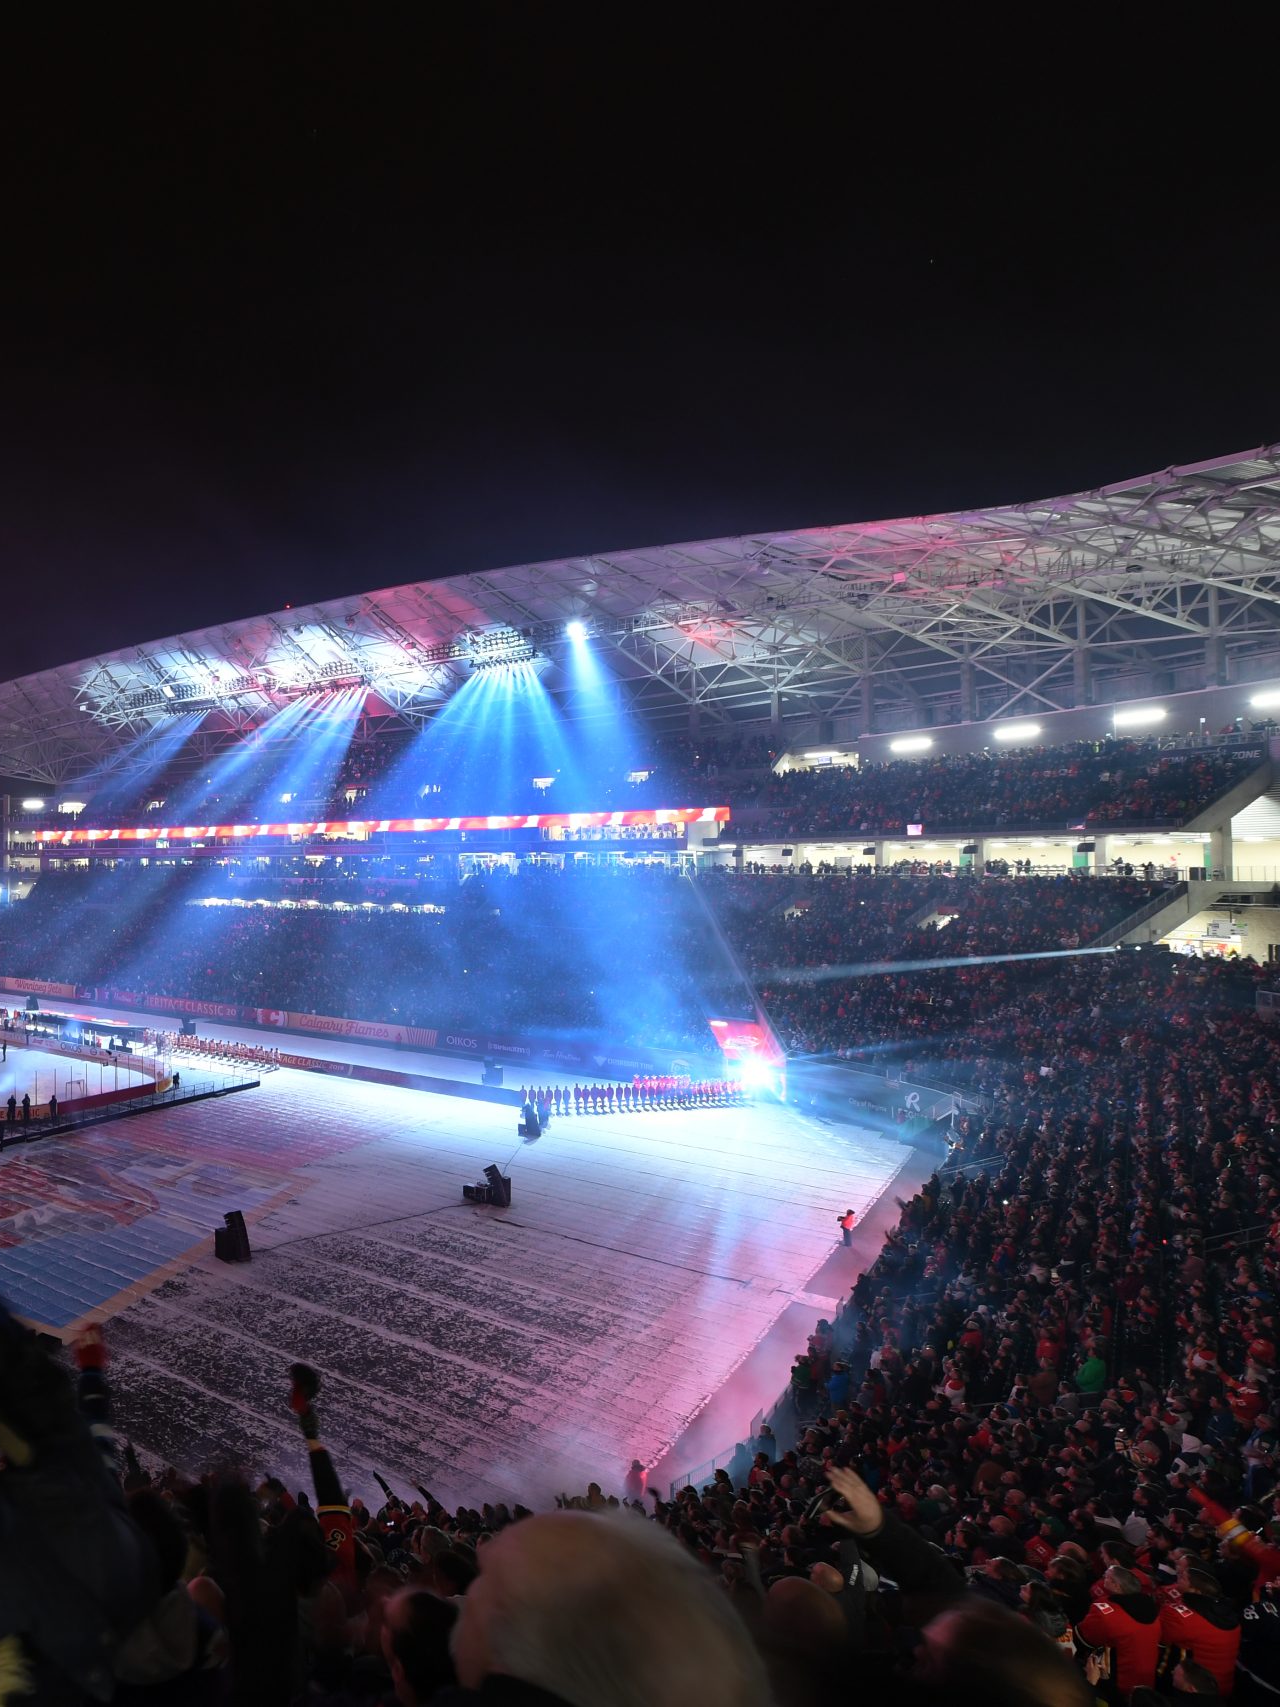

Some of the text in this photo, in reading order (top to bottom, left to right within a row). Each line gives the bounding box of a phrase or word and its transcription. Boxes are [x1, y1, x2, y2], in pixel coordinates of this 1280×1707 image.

[1232, 750, 1261, 760] ZONE
[15, 979, 62, 994] Winnipeg Jets
[185, 1000, 224, 1016] CLASSIC
[300, 1015, 389, 1038] Calgary Flames
[446, 1035, 478, 1049] OIKOS
